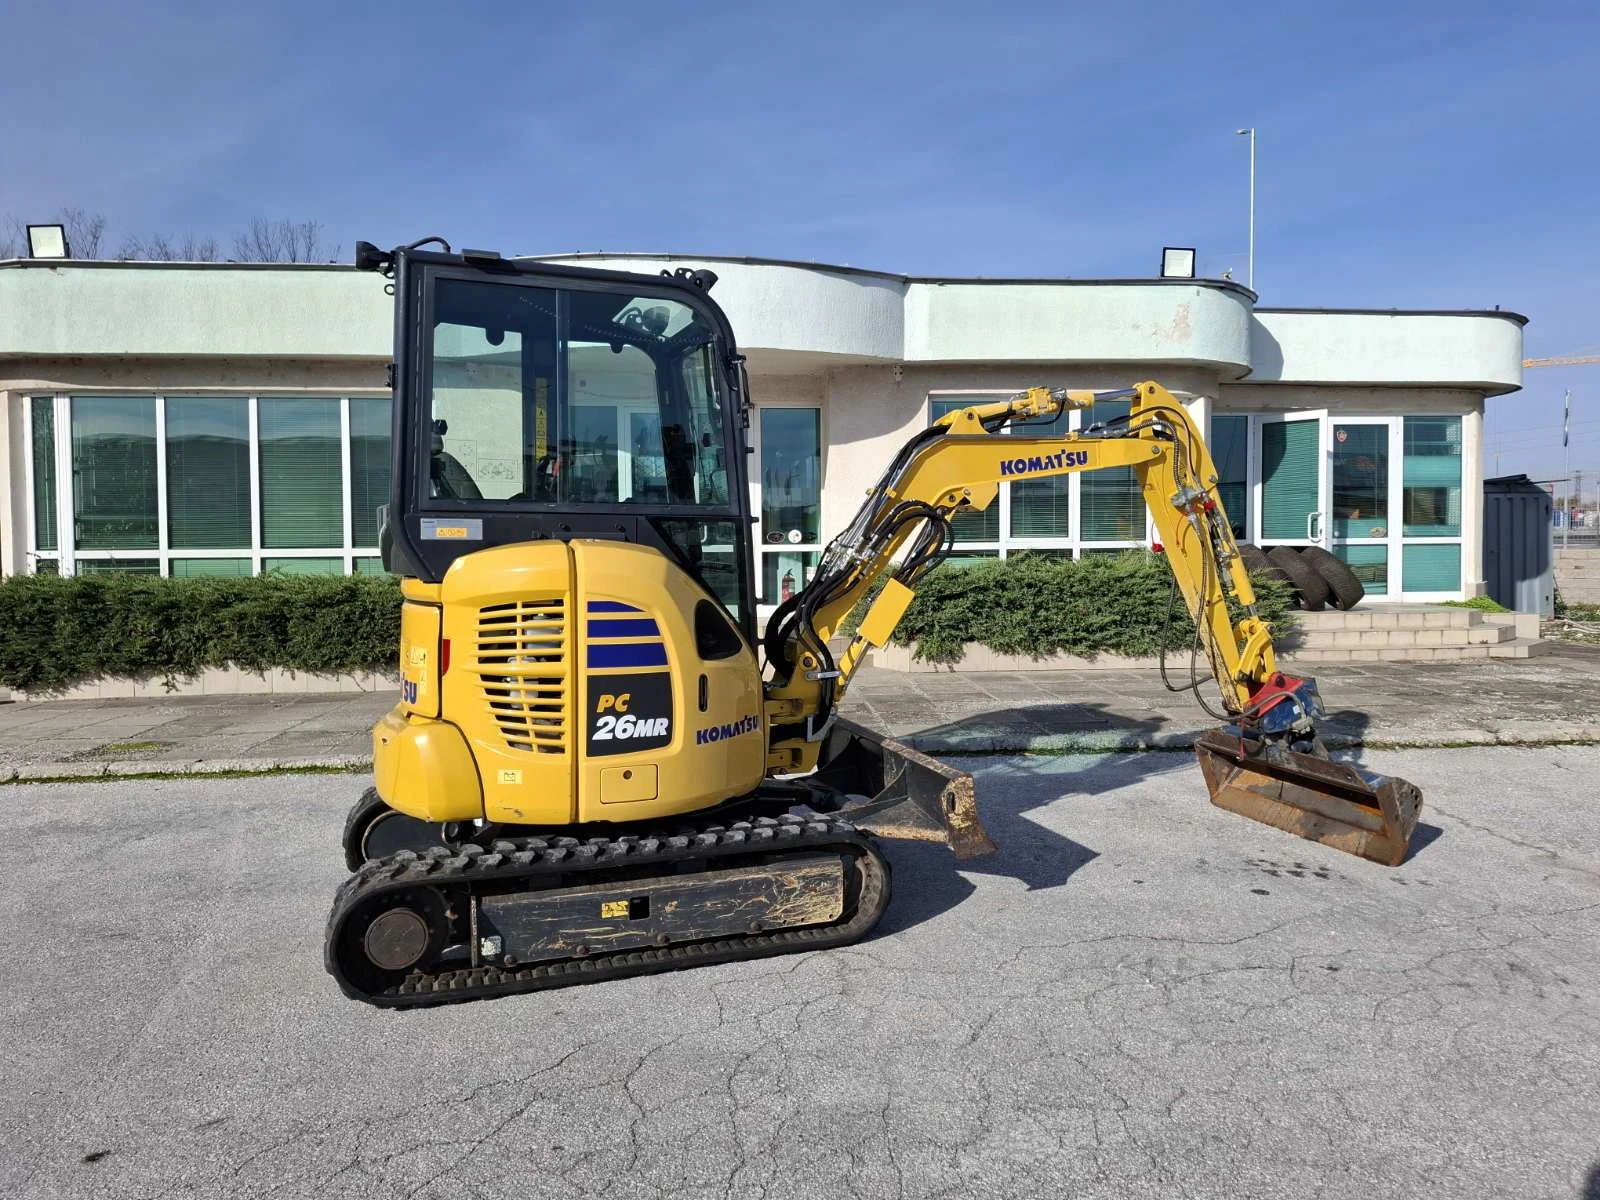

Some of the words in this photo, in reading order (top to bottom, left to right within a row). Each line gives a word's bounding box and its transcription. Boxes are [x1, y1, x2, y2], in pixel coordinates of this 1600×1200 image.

[1000, 449, 1087, 475] KOMATSU
[597, 693, 631, 713] PC
[592, 714, 669, 741] 26MR
[696, 715, 759, 745] KOMATSU
